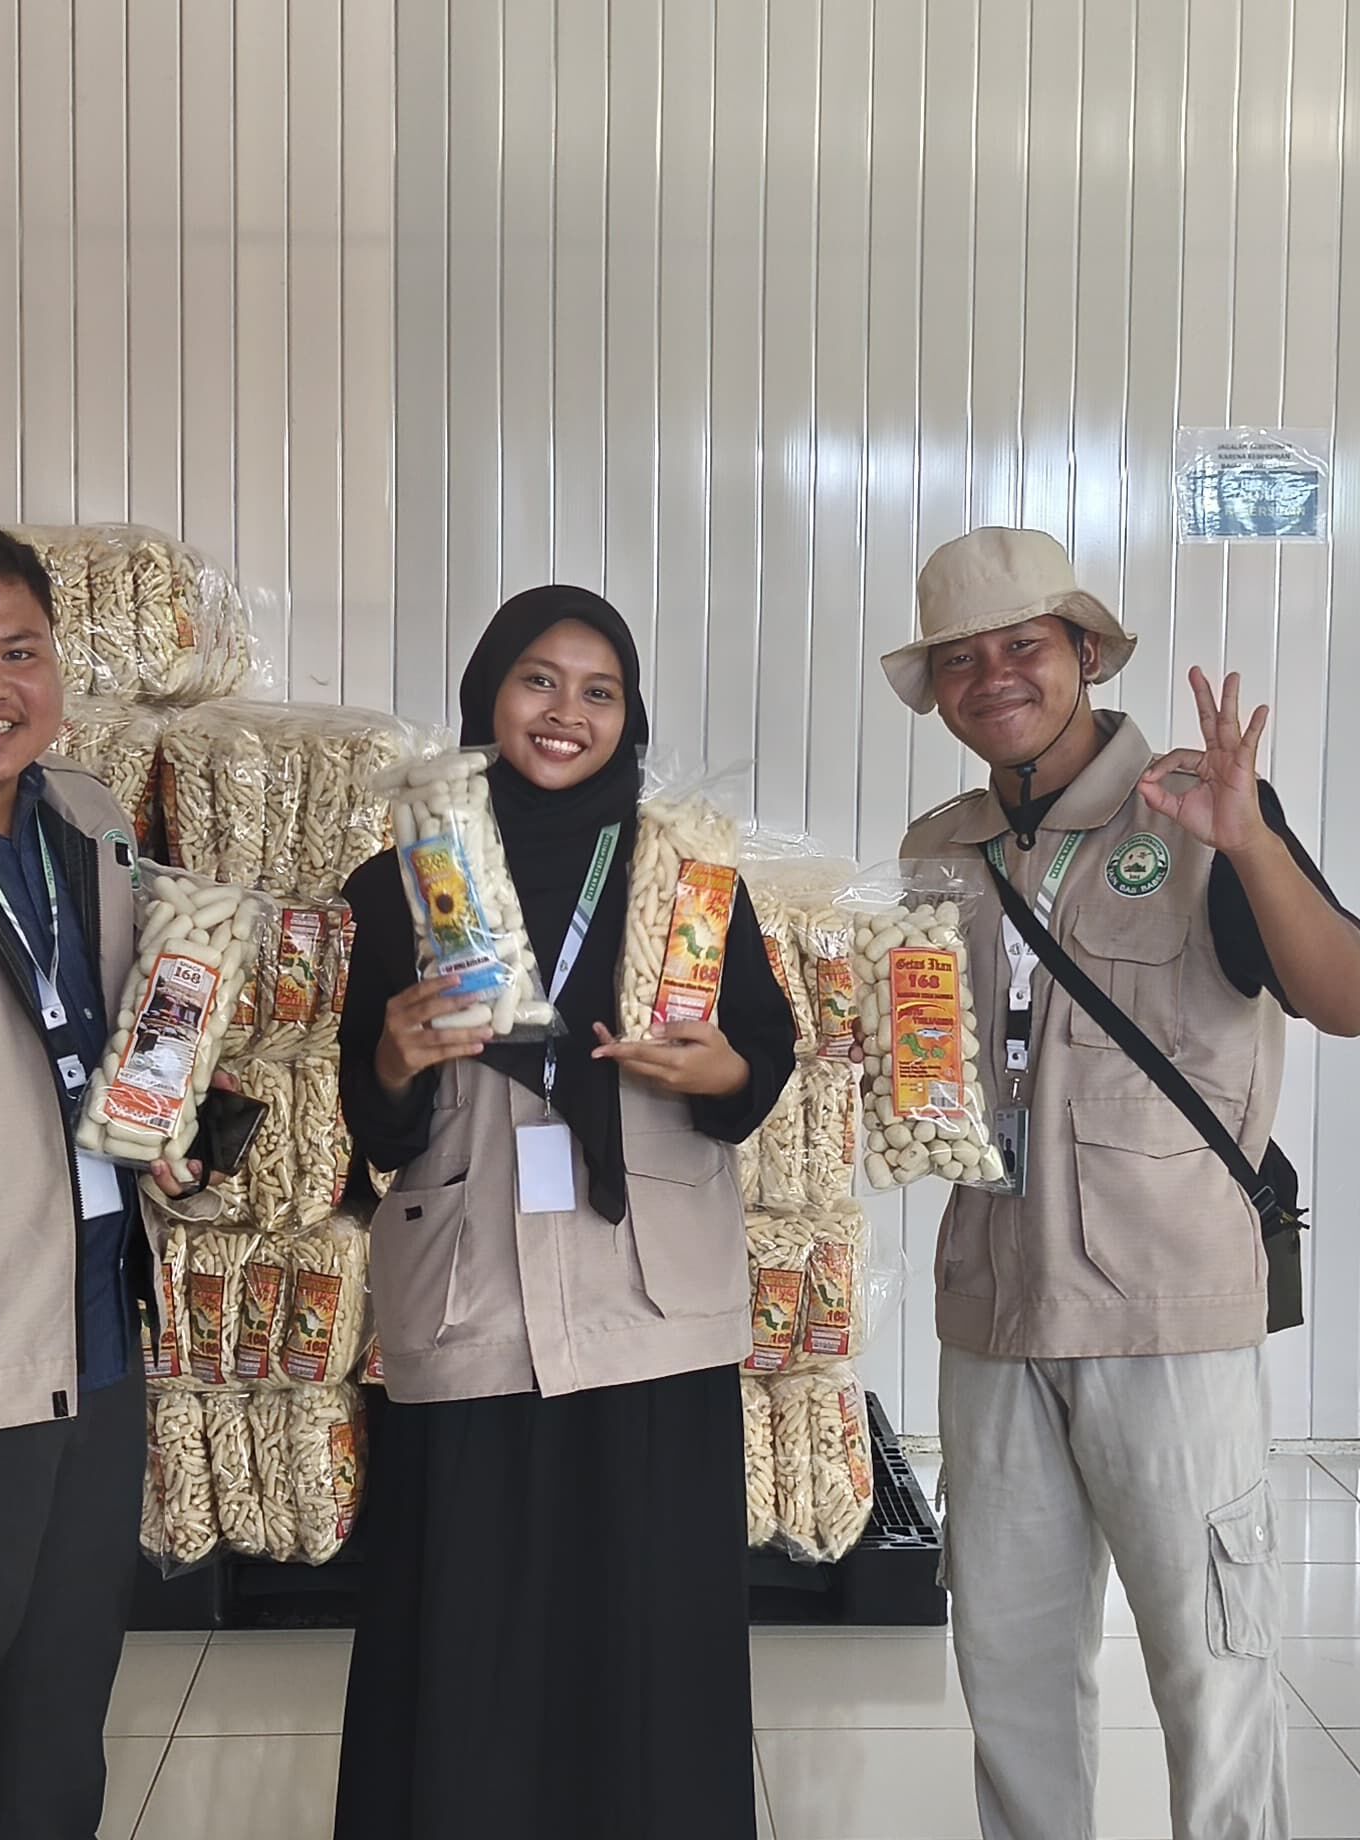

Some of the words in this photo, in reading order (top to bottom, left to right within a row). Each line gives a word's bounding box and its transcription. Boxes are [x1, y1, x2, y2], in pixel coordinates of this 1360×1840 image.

[174, 966, 202, 985] 168
[691, 964, 719, 982] 168
[908, 974, 940, 989] 168
